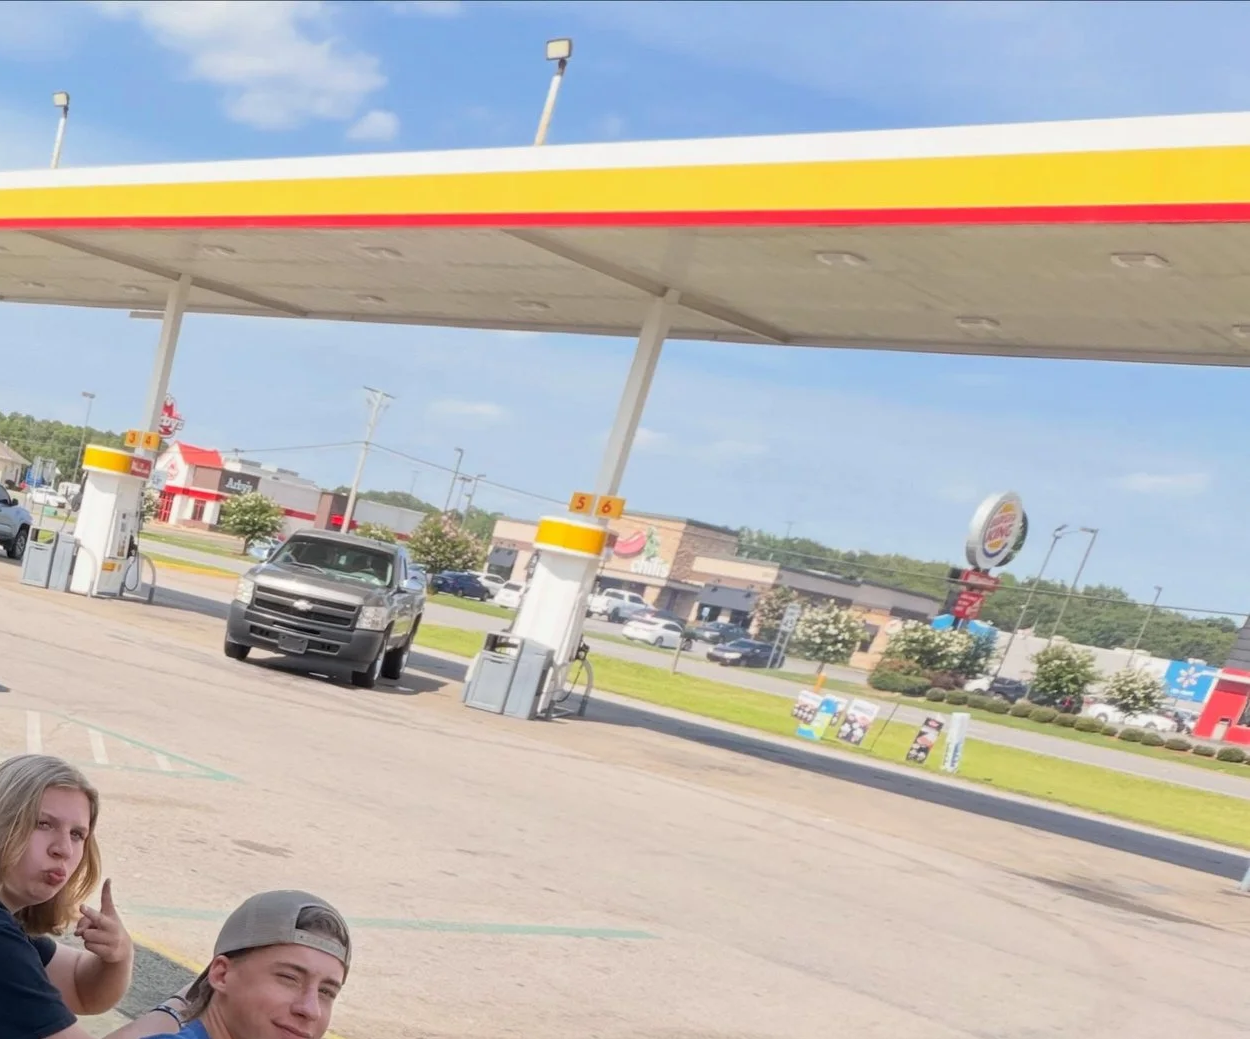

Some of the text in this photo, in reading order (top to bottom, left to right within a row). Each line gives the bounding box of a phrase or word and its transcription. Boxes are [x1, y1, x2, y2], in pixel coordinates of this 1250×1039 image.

[129, 433, 152, 445] 3 4
[576, 496, 611, 513] 5 6
